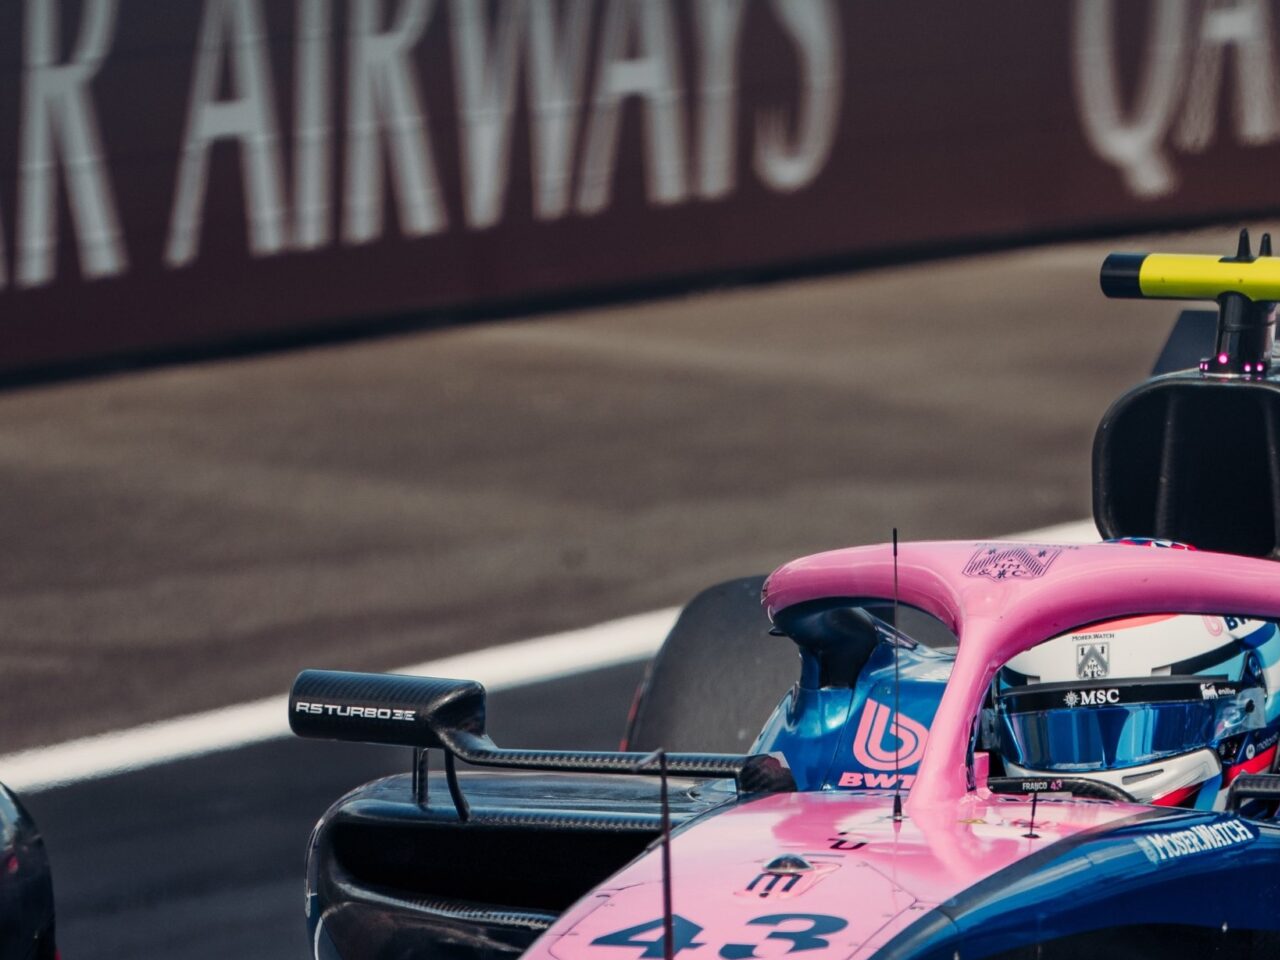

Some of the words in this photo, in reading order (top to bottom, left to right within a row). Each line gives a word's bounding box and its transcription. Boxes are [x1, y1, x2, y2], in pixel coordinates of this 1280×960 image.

[0, 0, 127, 288] R
[1080, 688, 1120, 705] MSC
[838, 771, 917, 790] BWT
[588, 913, 849, 960] 43
